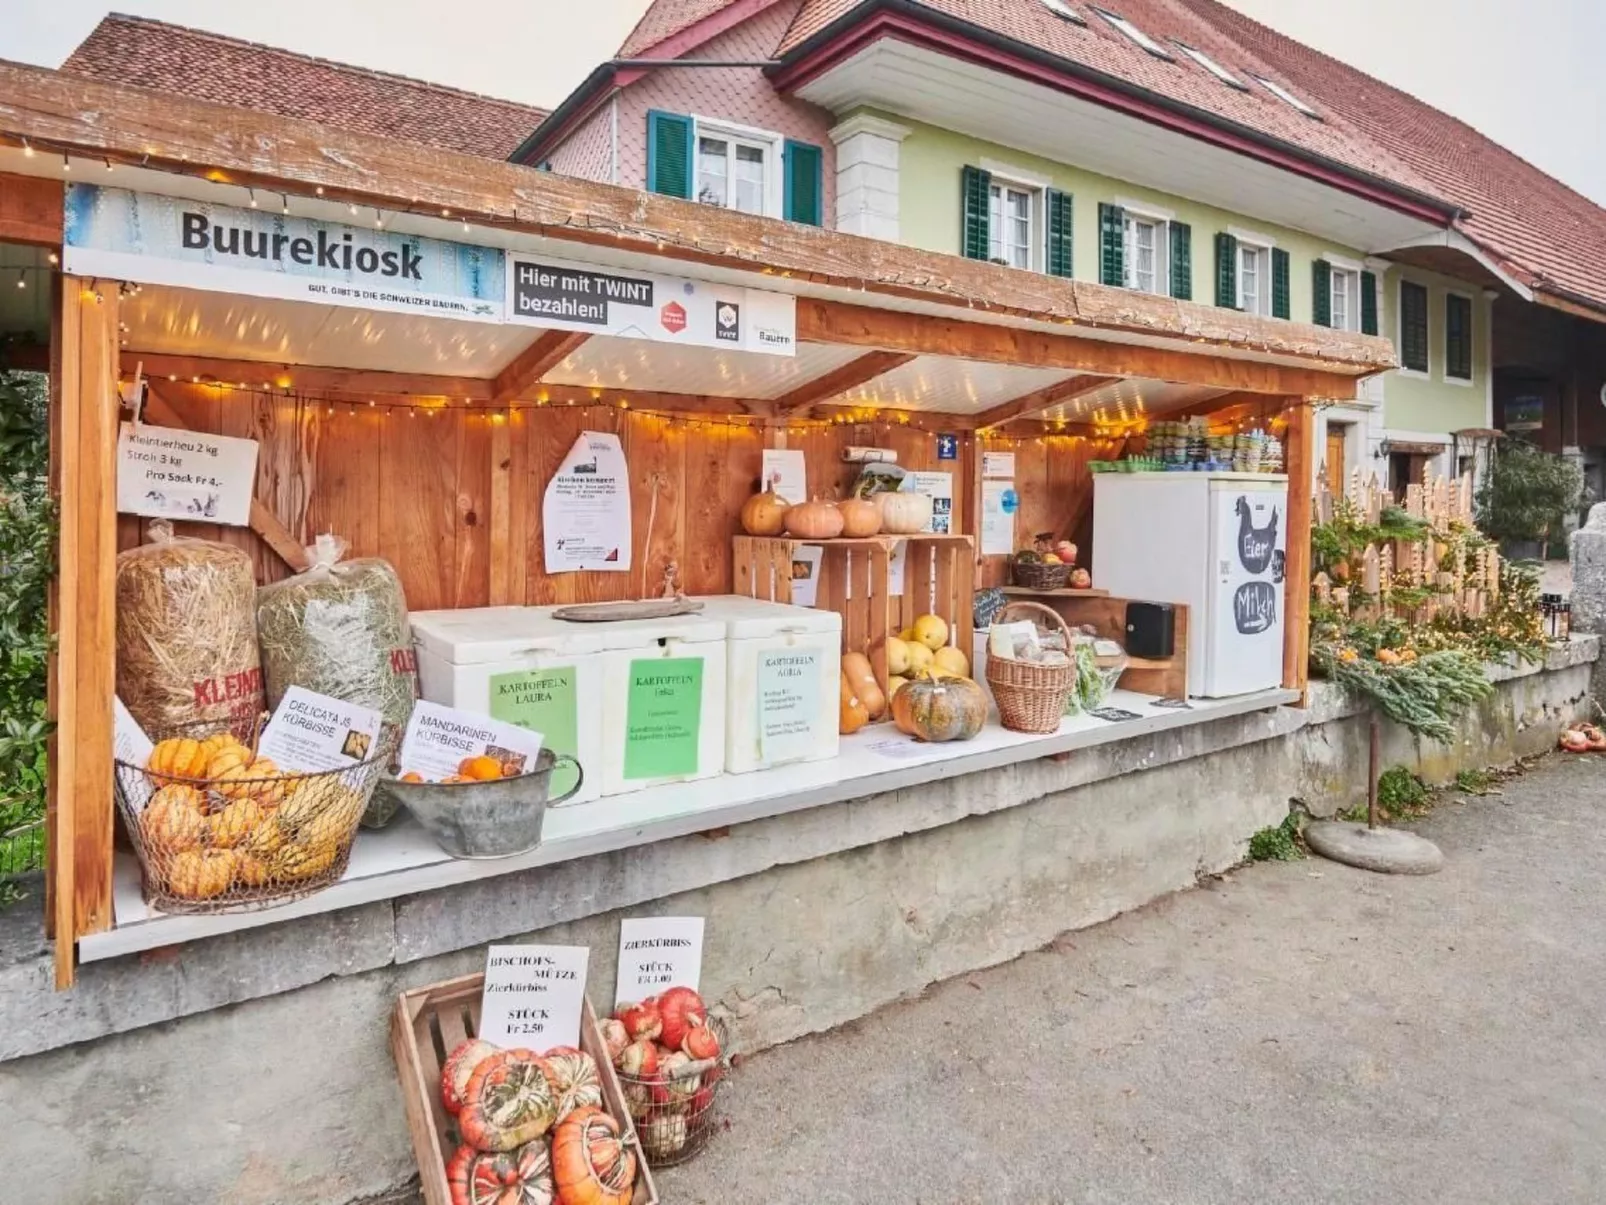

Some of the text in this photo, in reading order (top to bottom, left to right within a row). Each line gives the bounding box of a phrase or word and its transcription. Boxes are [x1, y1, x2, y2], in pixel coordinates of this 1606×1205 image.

[182, 211, 423, 281] Buurekiosk
[519, 266, 650, 301] Hier mit TWINT
[362, 290, 378, 301] DIE
[379, 293, 431, 307] SCHWEIZER
[519, 291, 604, 319] bezahlen!
[196, 443, 204, 453] 2
[205, 444, 219, 457] kg
[159, 454, 168, 465] 3
[146, 469, 165, 481] Pro
[168, 472, 193, 484] Sack
[1243, 533, 1270, 558] Eier
[1237, 585, 1275, 620] Milch
[498, 677, 568, 695] KARTOFFELN
[636, 675, 694, 687] KARTOFFELN
[515, 692, 552, 704] LAURA
[288, 699, 339, 724] DELICATA
[282, 712, 337, 739] KÜRBISSE
[420, 715, 497, 743] MANDARINEN
[416, 727, 475, 752] KÜRBISSE
[624, 937, 692, 950] ZIERKÜRBISS
[490, 956, 556, 967] BISCHOFS-
[638, 960, 673, 973] STÜCK
[534, 967, 578, 980] MÜTZE
[486, 982, 548, 993] Zierkürbiss
[507, 1006, 550, 1020] STÜCK
[506, 1022, 544, 1034] Fr 2.50
